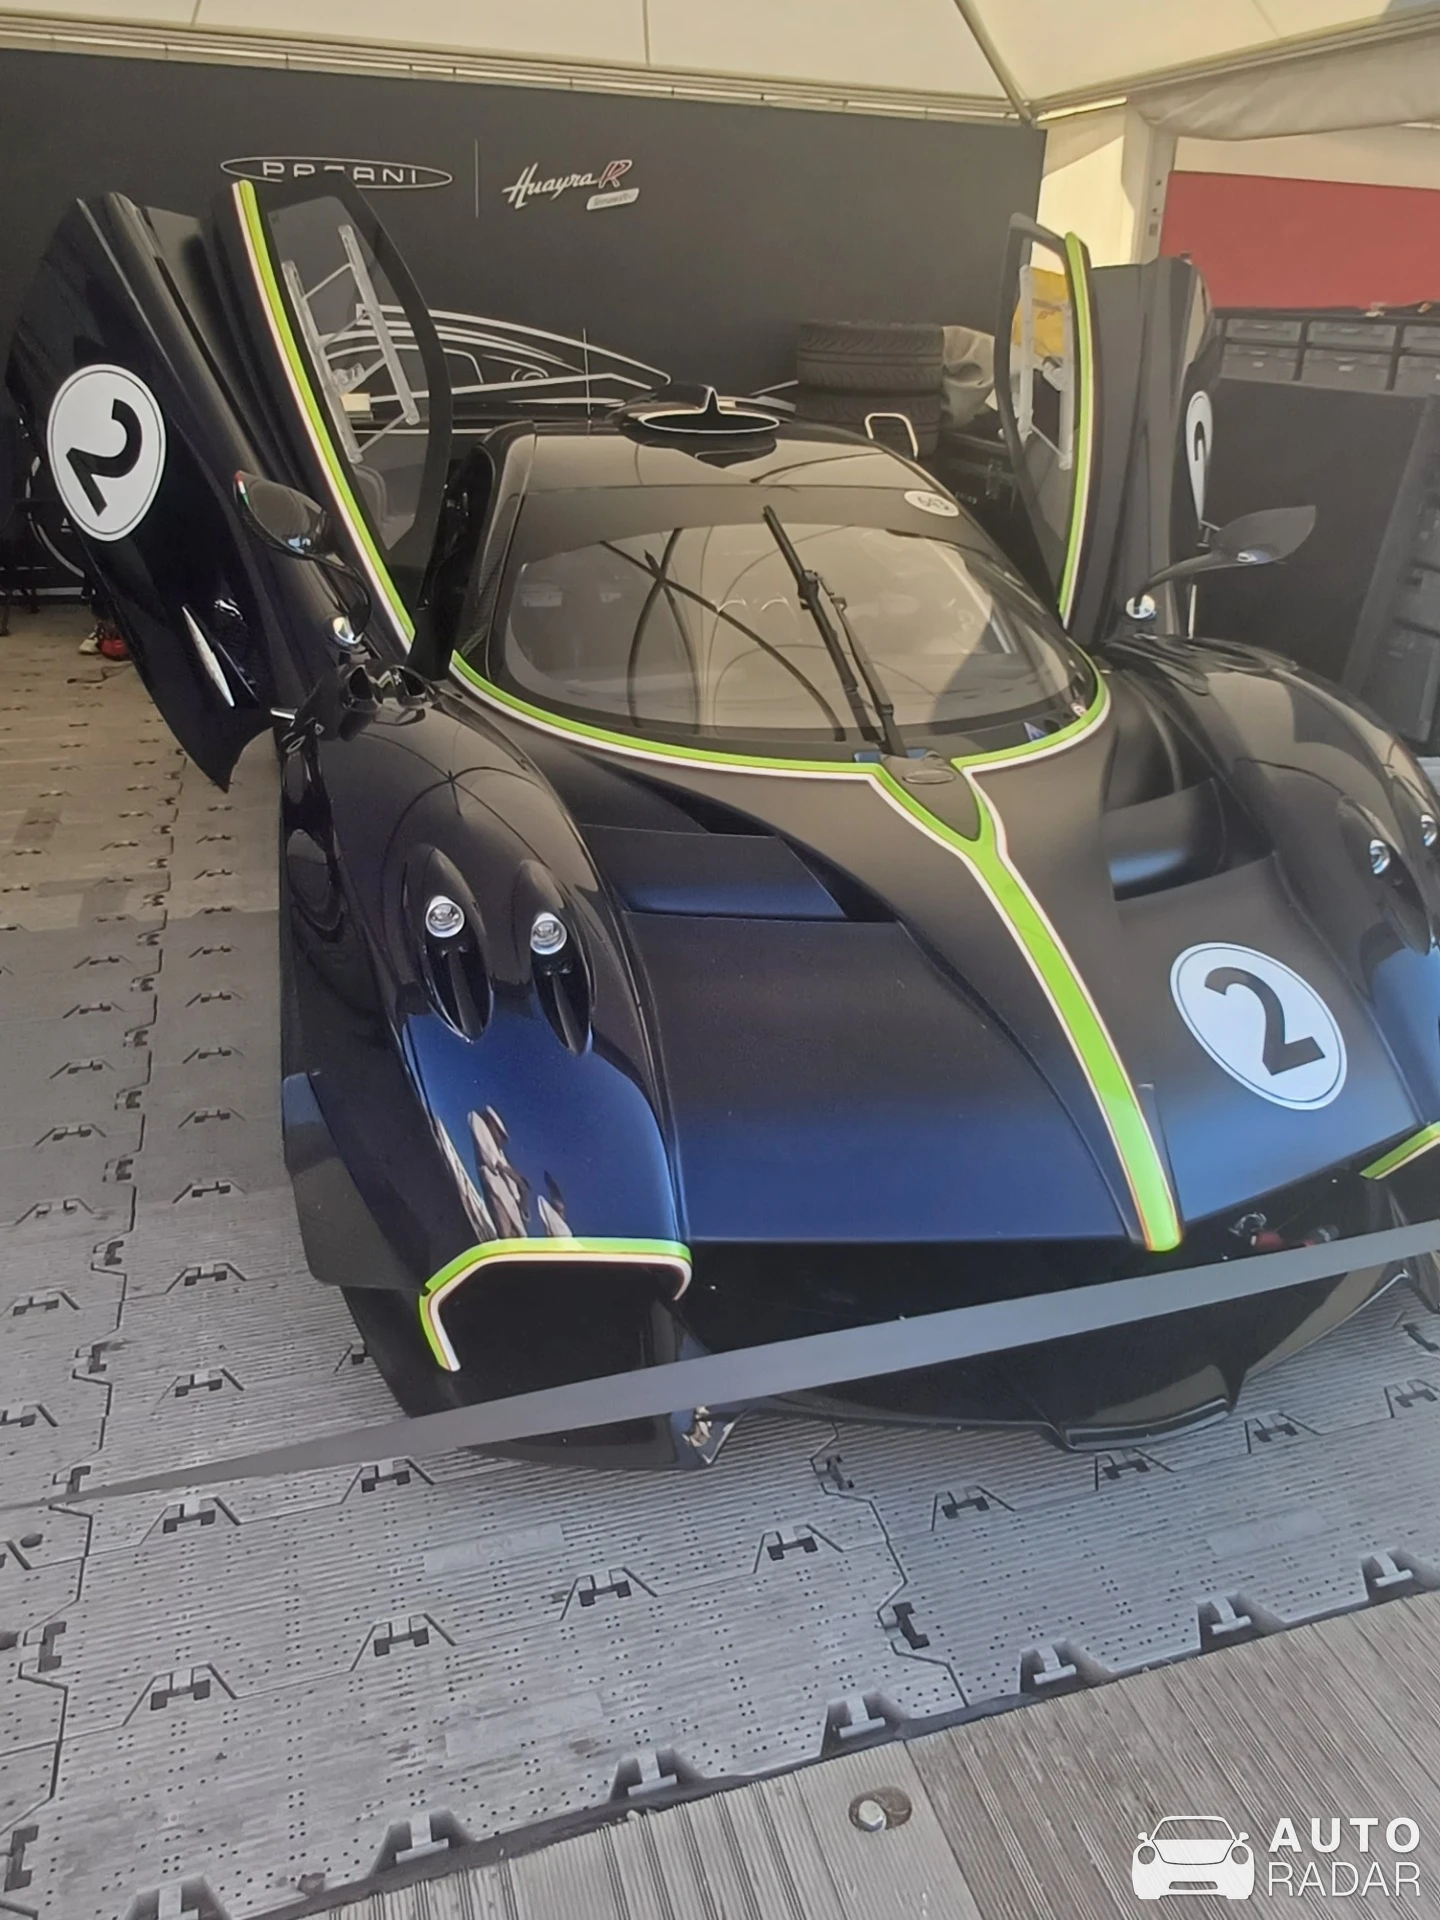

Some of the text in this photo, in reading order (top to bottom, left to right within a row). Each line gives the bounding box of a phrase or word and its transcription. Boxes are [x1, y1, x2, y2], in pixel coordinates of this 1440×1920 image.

[262, 161, 417, 184] PAANI
[501, 159, 633, 210] Huayra R
[65, 398, 143, 517] 2
[1204, 966, 1326, 1077] 2
